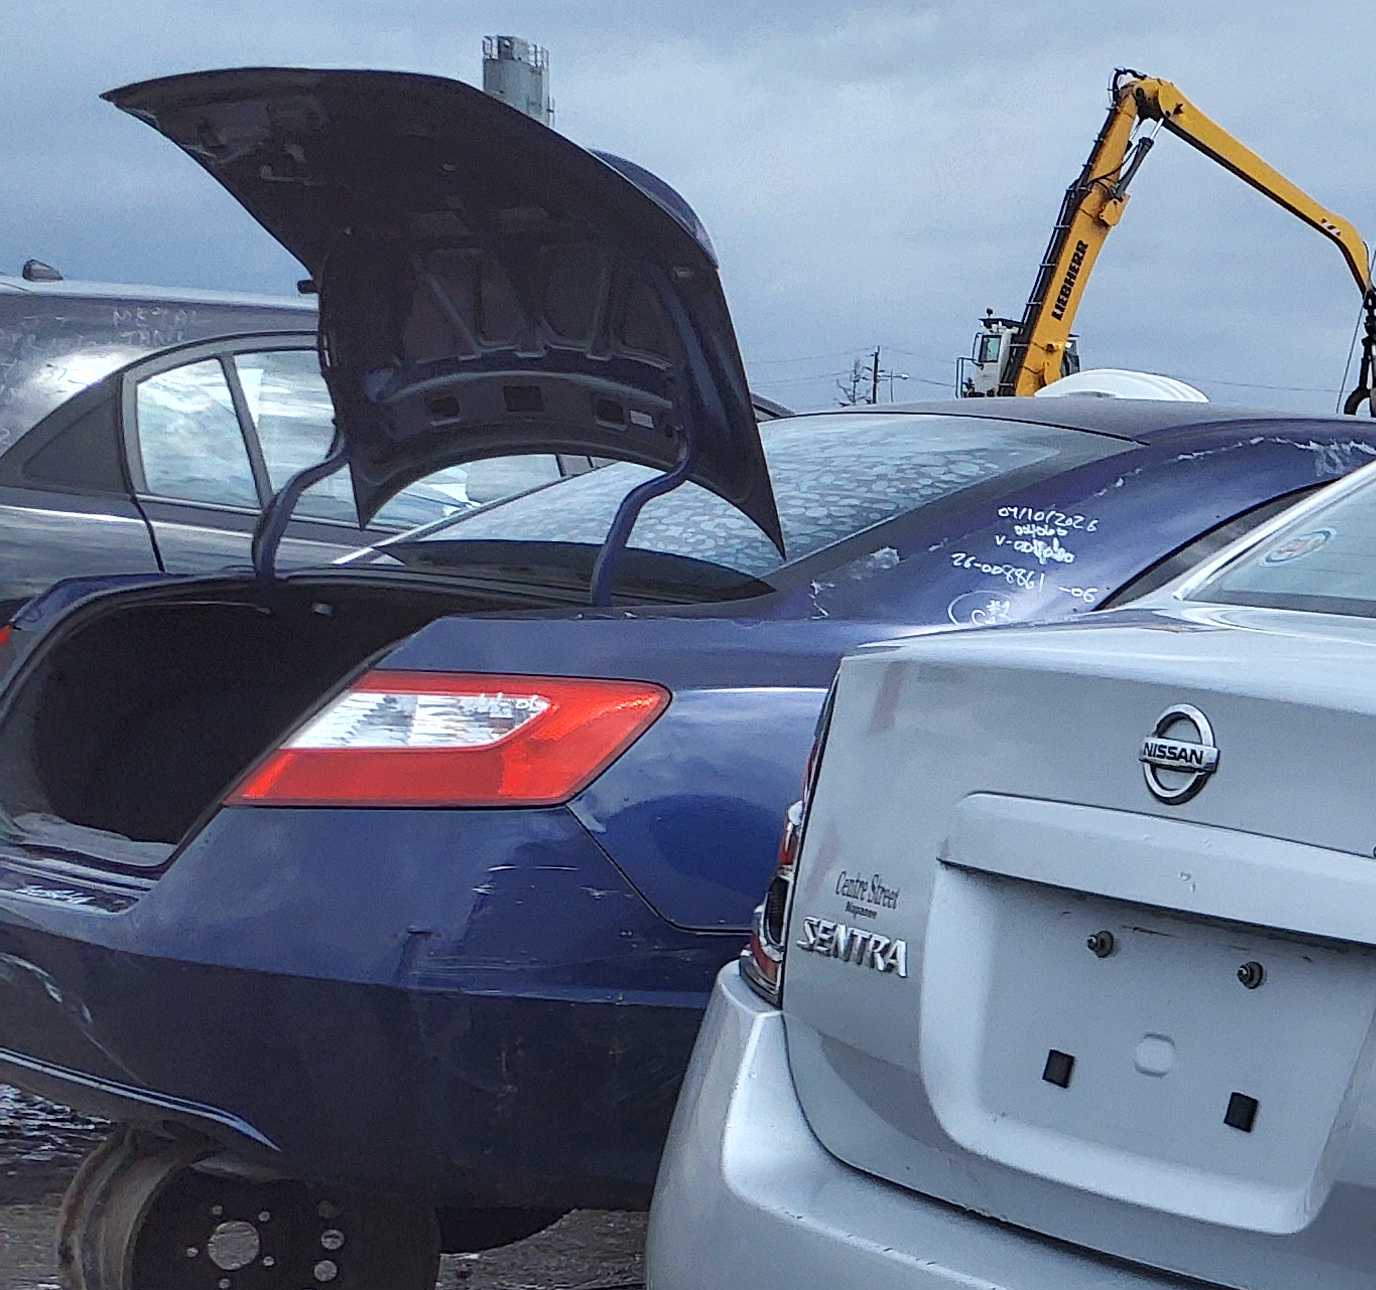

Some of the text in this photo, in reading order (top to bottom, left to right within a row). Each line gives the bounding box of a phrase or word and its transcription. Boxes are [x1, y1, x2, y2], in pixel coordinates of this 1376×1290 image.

[1051, 239, 1089, 321] LIEBHERR
[1143, 742, 1204, 765] NISSAN
[796, 916, 908, 978] SENTRA
